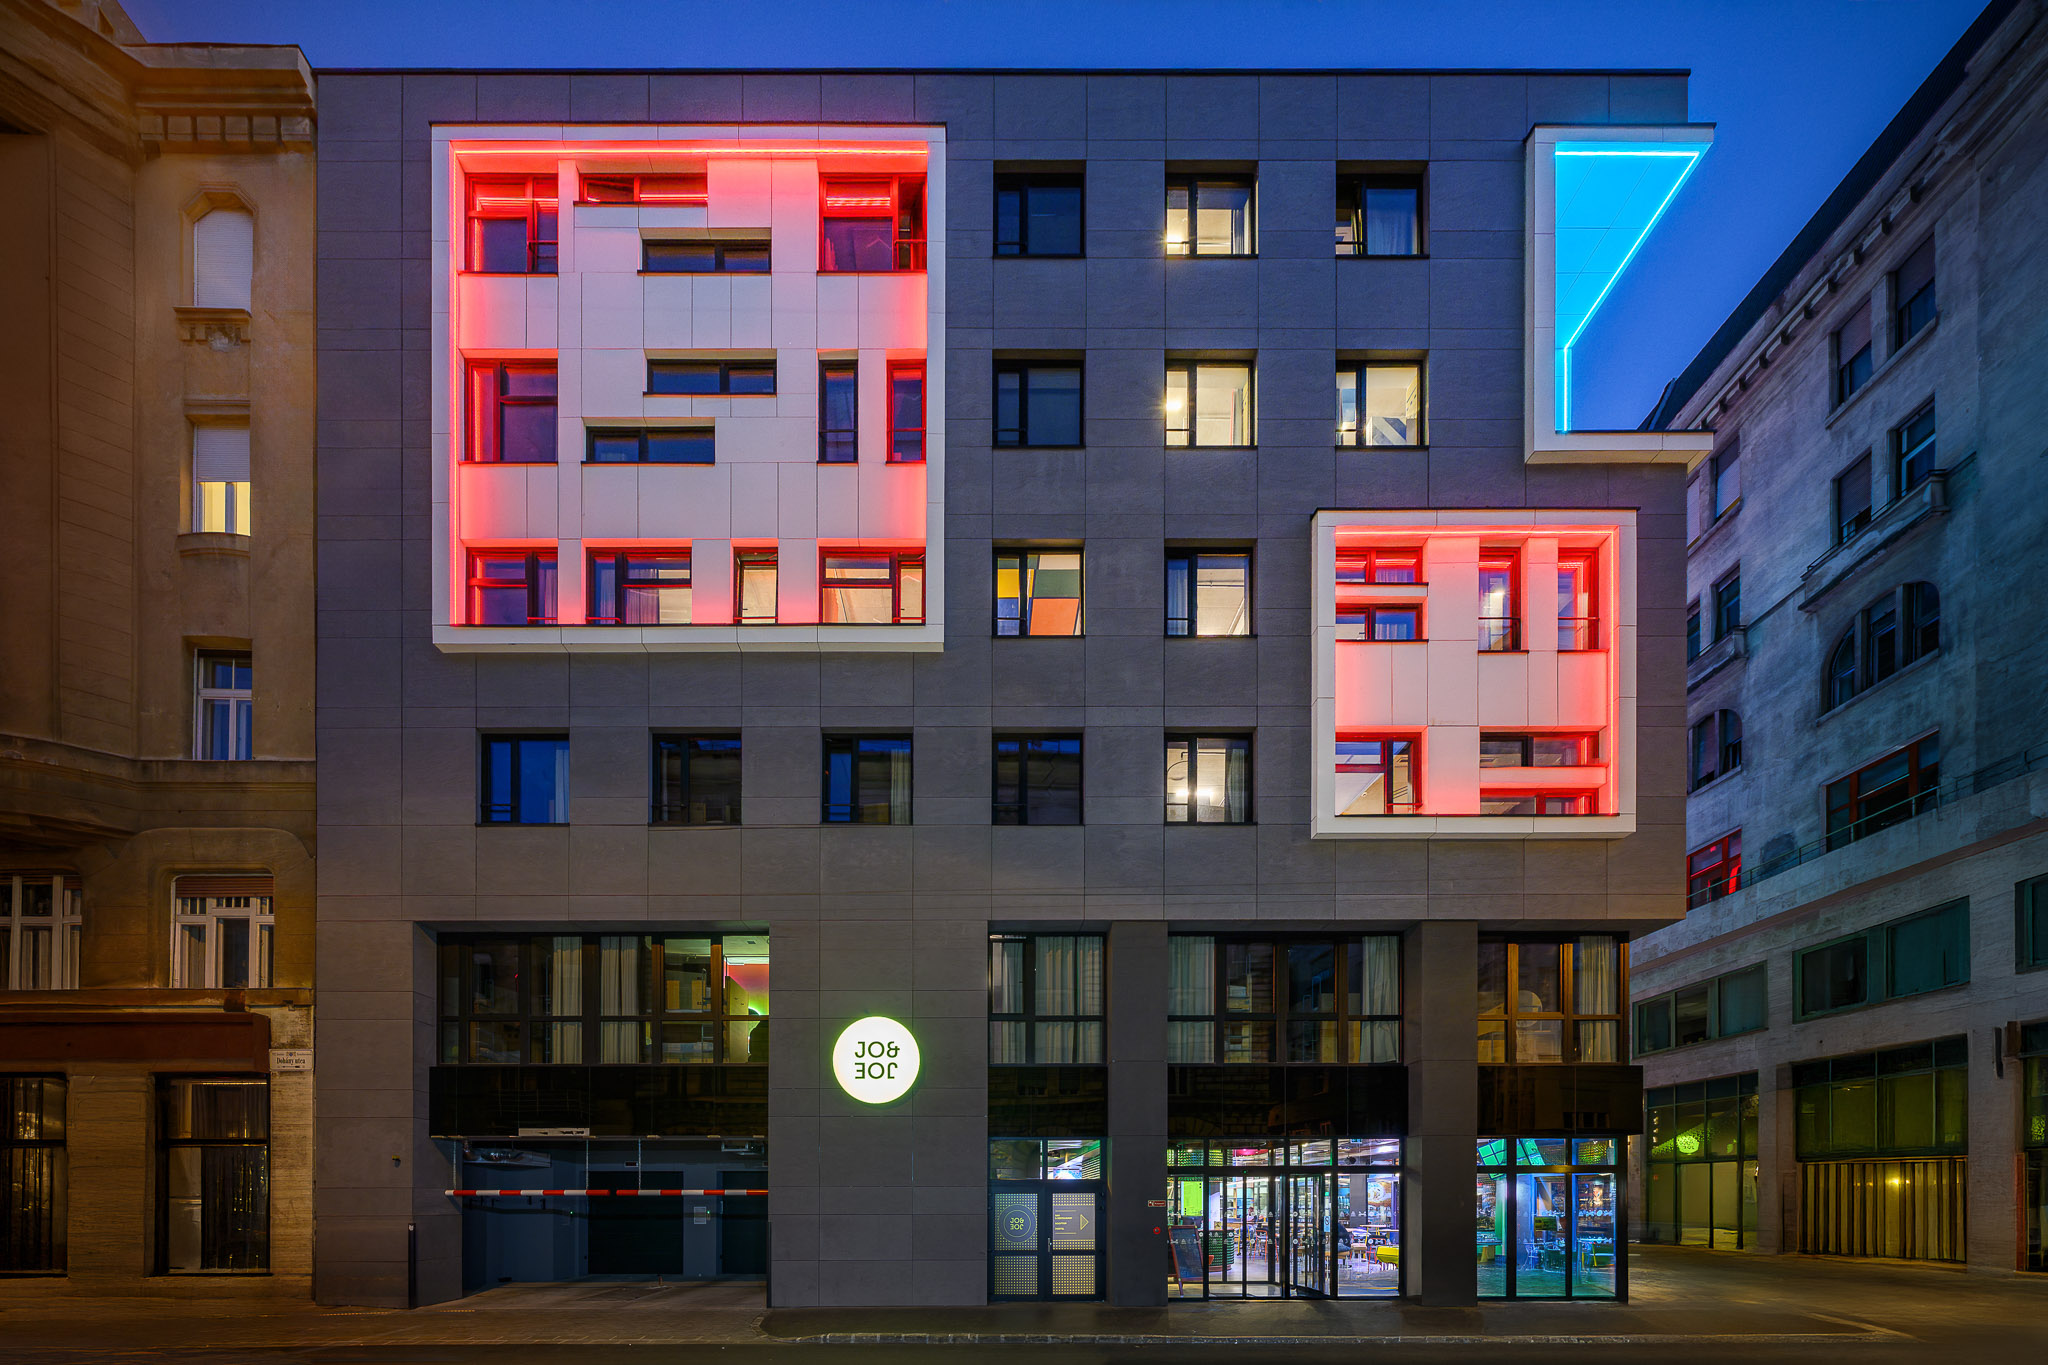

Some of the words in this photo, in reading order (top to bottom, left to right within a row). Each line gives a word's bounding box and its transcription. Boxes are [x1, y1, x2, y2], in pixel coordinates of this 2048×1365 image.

[855, 1041, 900, 1058] JO&
[854, 1062, 898, 1079] JOE
[1010, 1223, 1024, 1231] JOE
